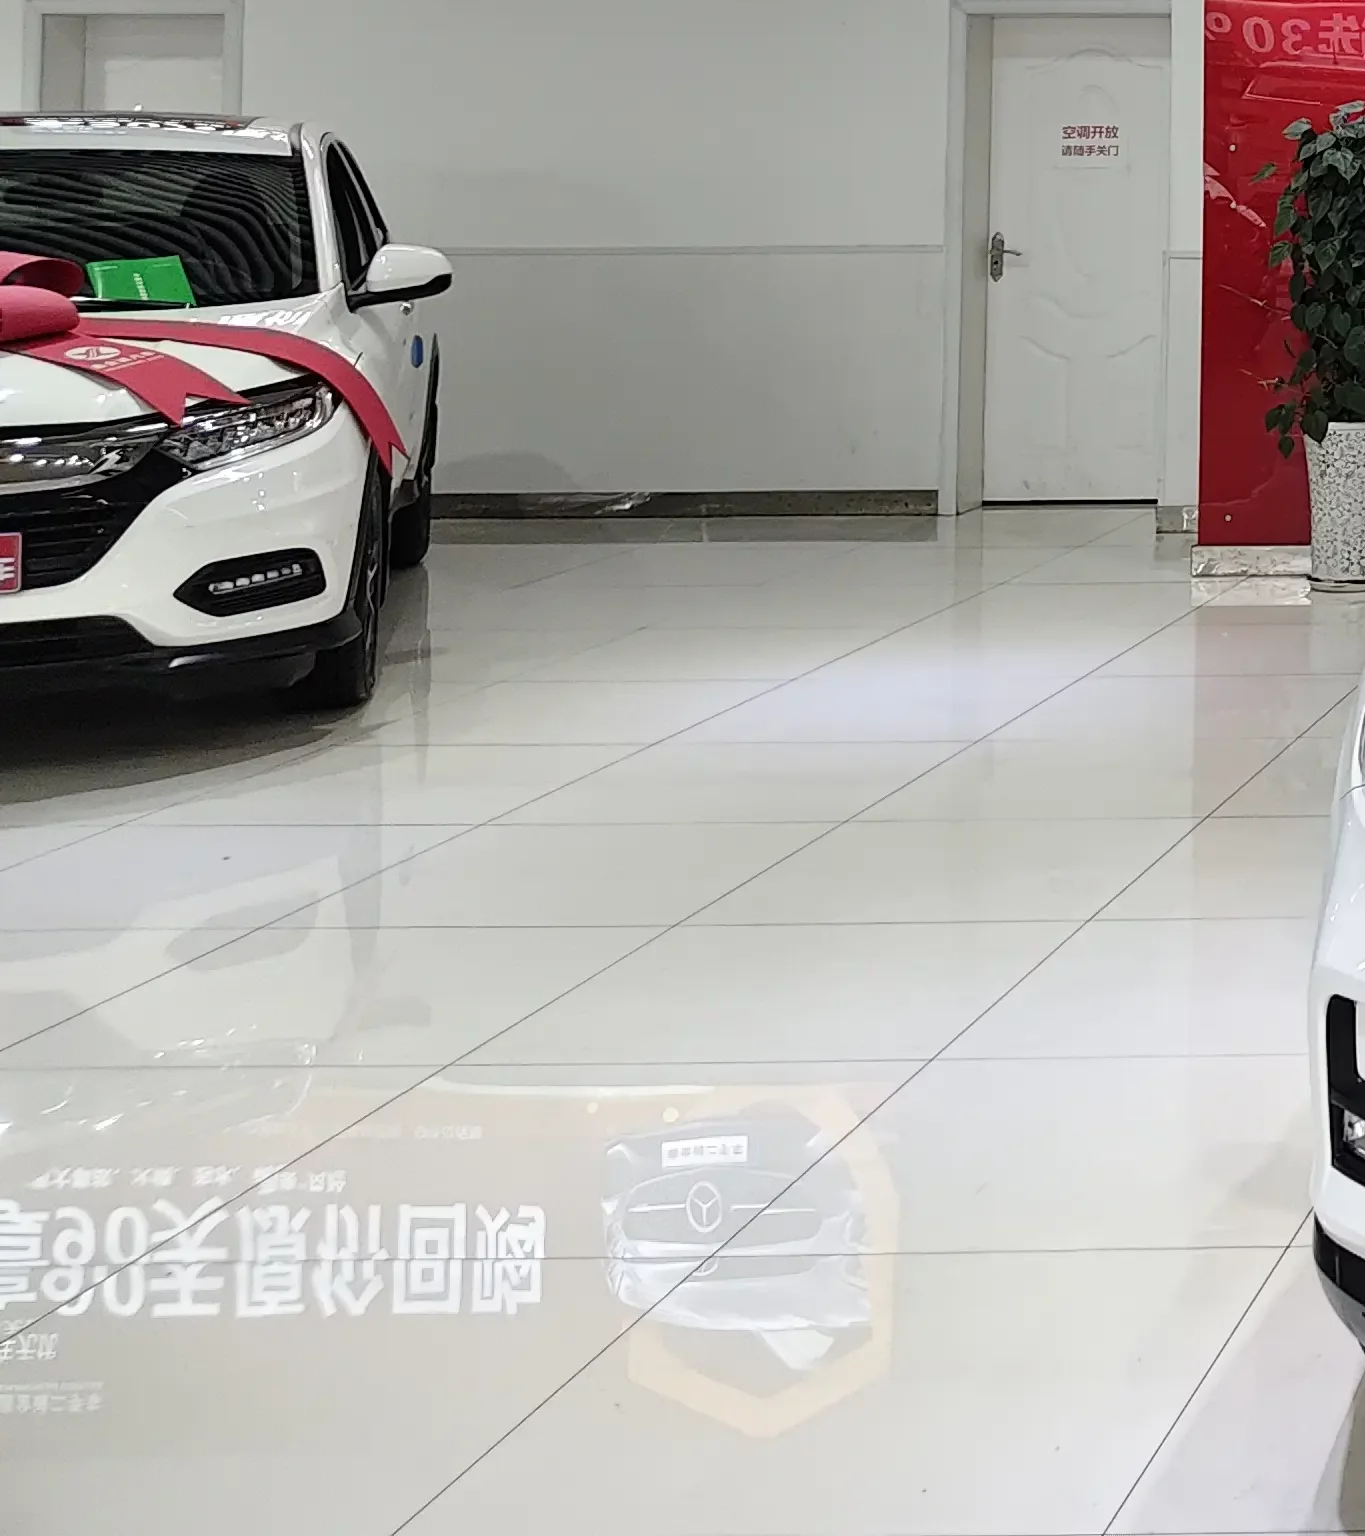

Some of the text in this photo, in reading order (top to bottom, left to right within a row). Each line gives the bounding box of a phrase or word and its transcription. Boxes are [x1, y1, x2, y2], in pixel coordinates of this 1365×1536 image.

[1062, 125, 1119, 139] 空调开放
[1062, 145, 1119, 156] 请随手关门
